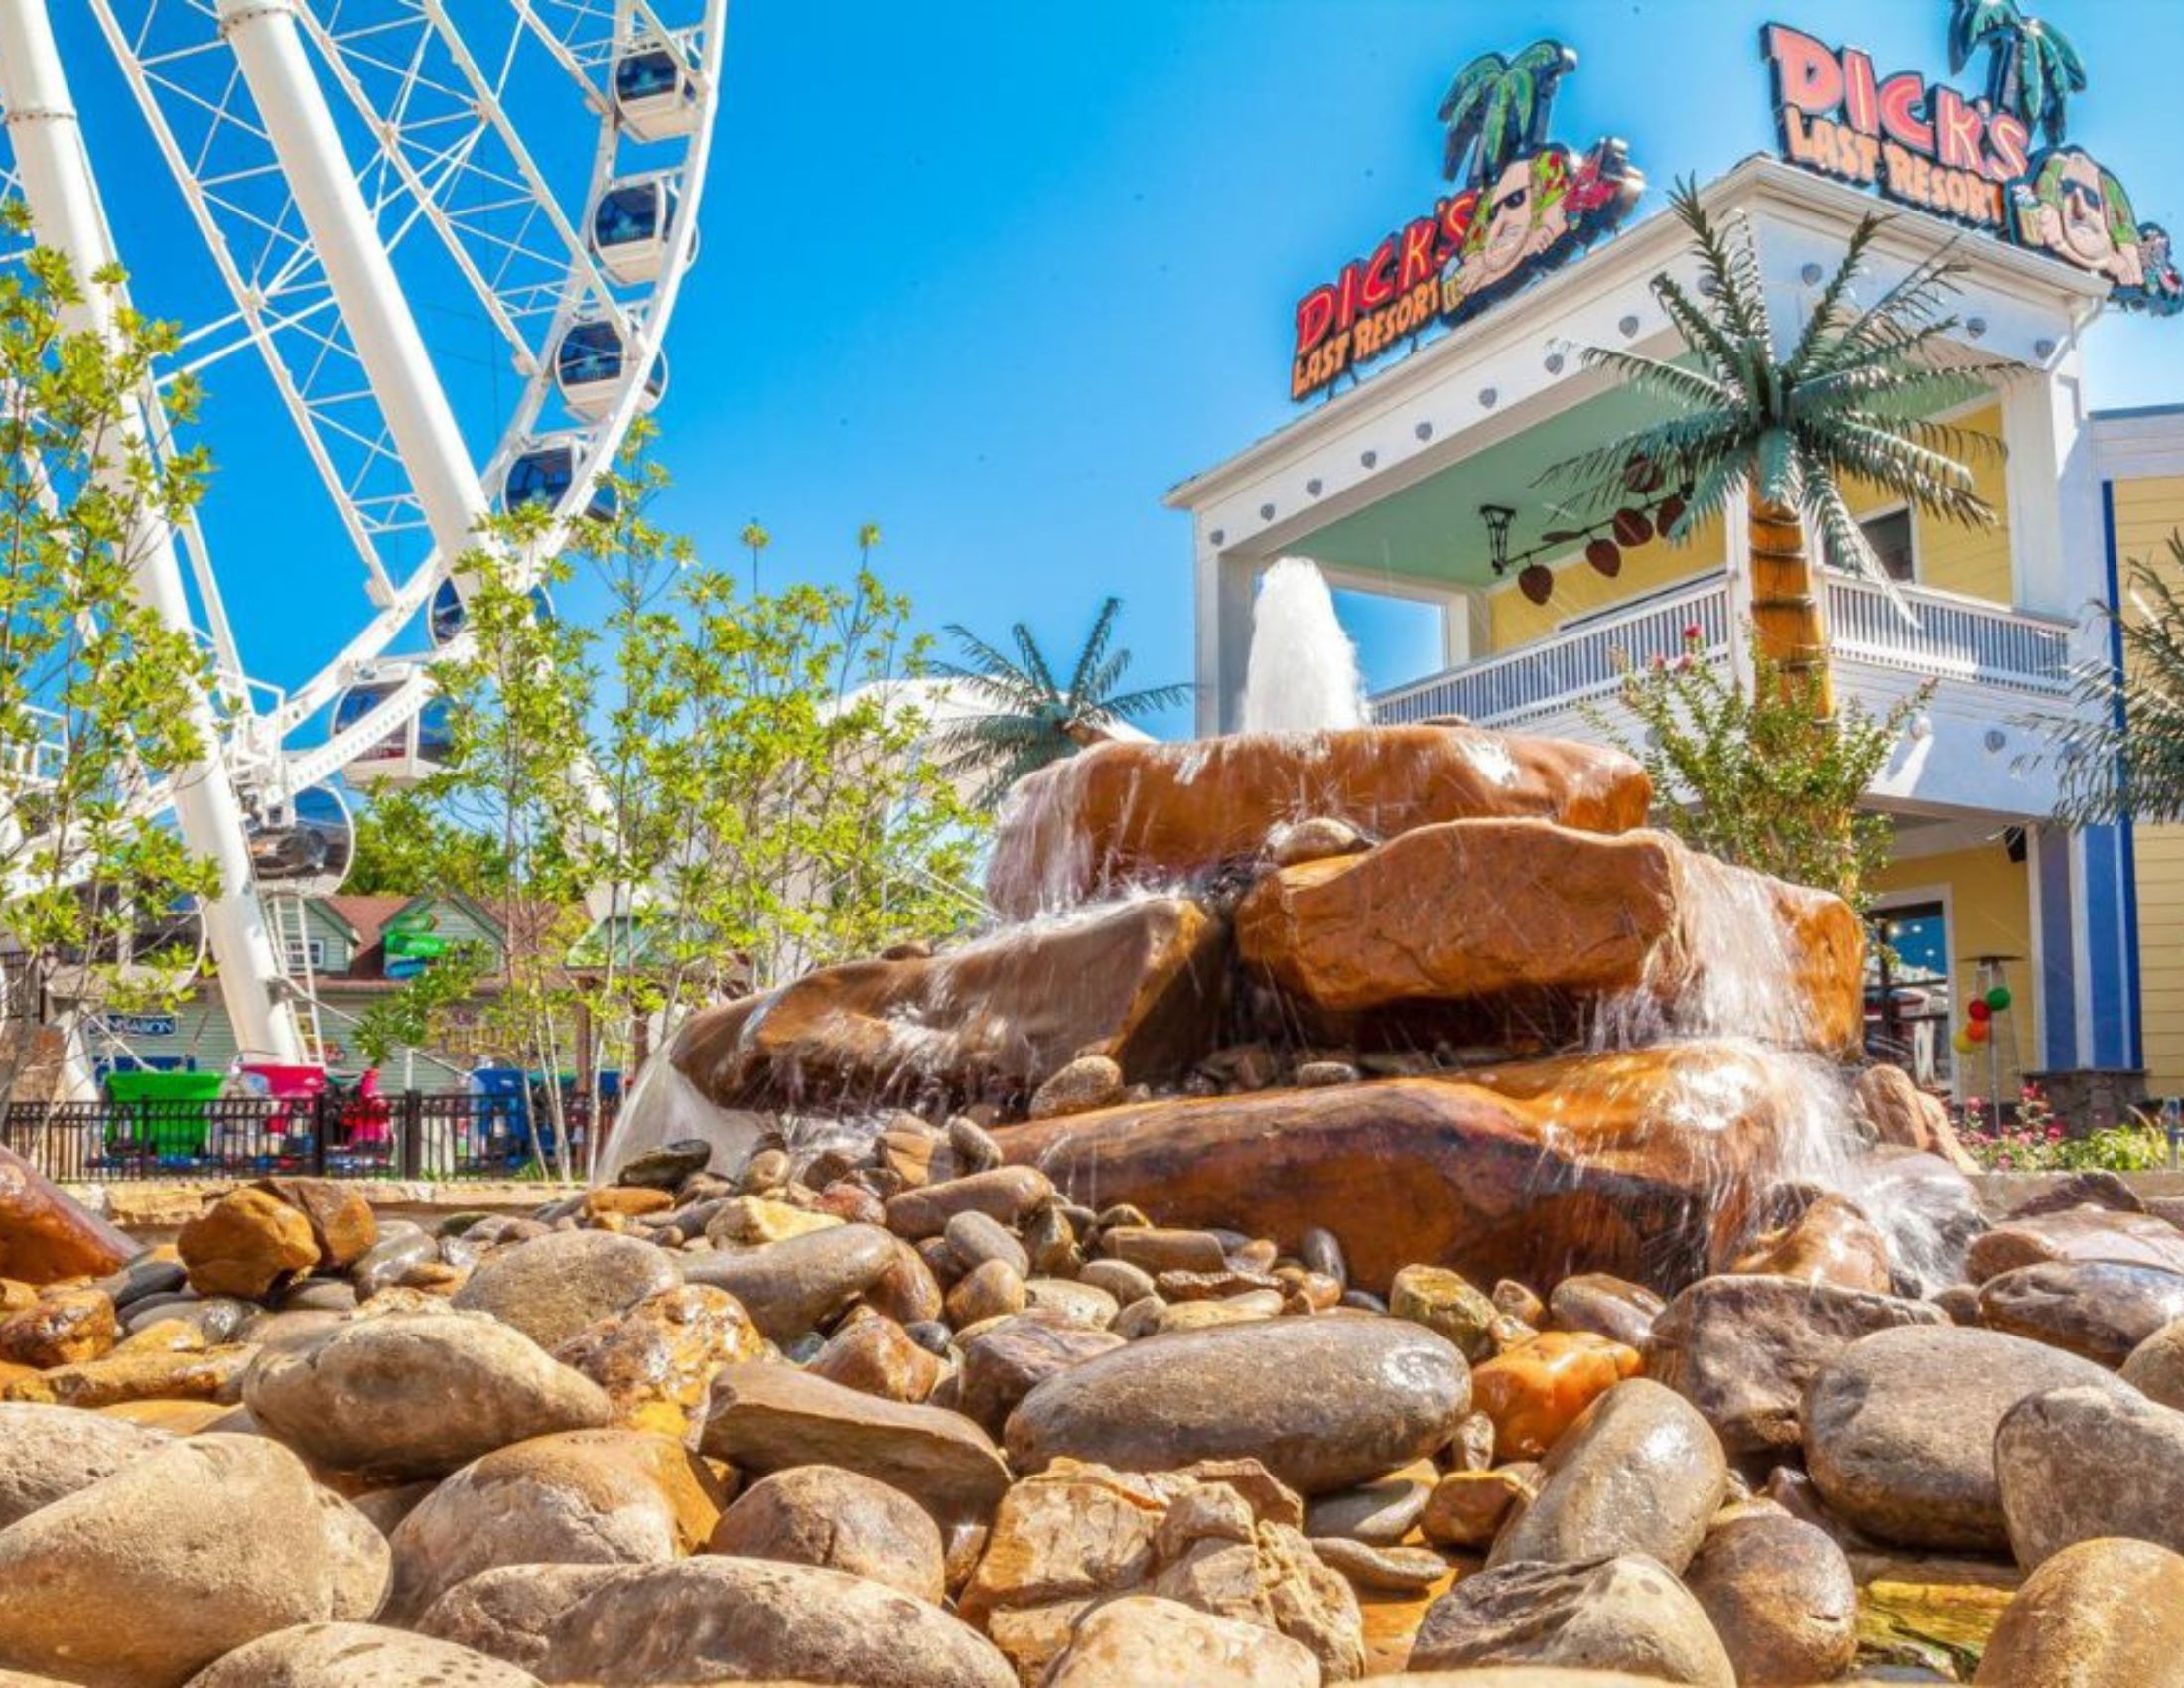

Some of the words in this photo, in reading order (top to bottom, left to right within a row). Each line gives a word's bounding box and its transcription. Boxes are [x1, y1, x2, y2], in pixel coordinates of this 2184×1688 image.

[1768, 25, 2028, 182] DICK'S
[1785, 106, 1879, 182] LAST
[1883, 141, 2003, 224] RESORT
[1293, 331, 1351, 398] LAST
[1353, 275, 1439, 361] RESORT
[1297, 189, 1476, 354] DICK'S
